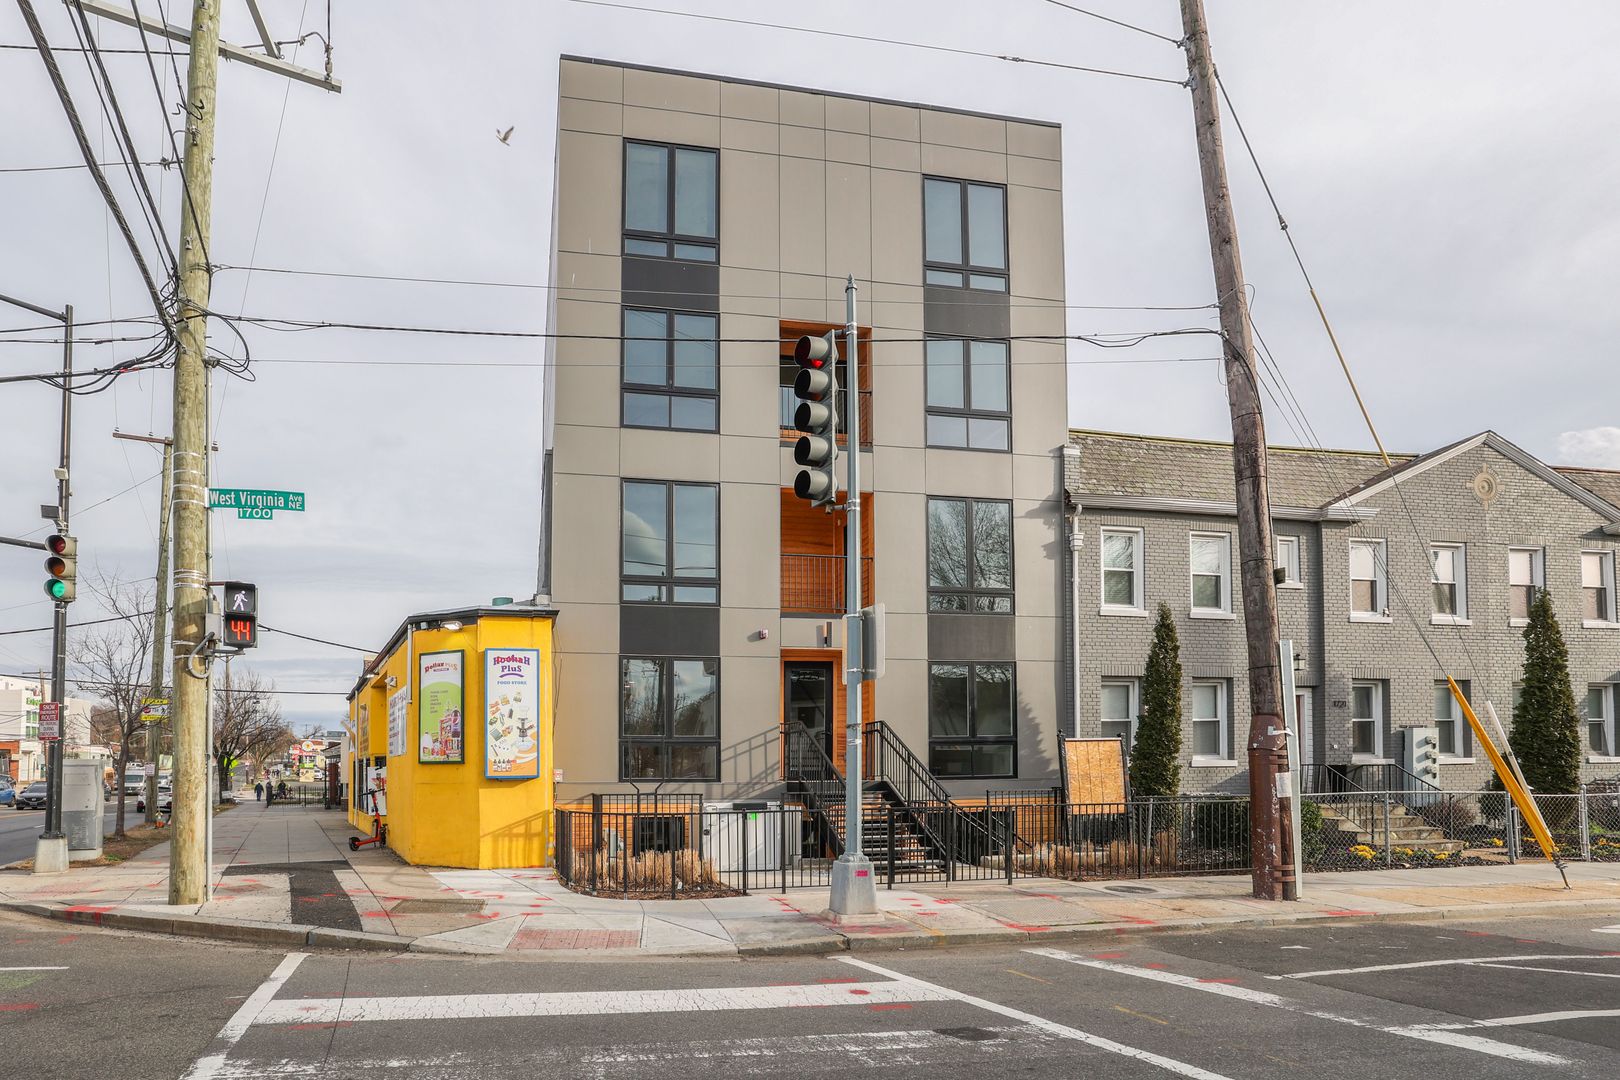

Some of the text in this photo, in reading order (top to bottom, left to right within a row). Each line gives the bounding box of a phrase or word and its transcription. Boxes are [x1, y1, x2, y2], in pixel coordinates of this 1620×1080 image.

[209, 490, 284, 509] West Virginia
[288, 494, 303, 502] Ave
[239, 508, 271, 518] 1700
[231, 620, 250, 640] 44
